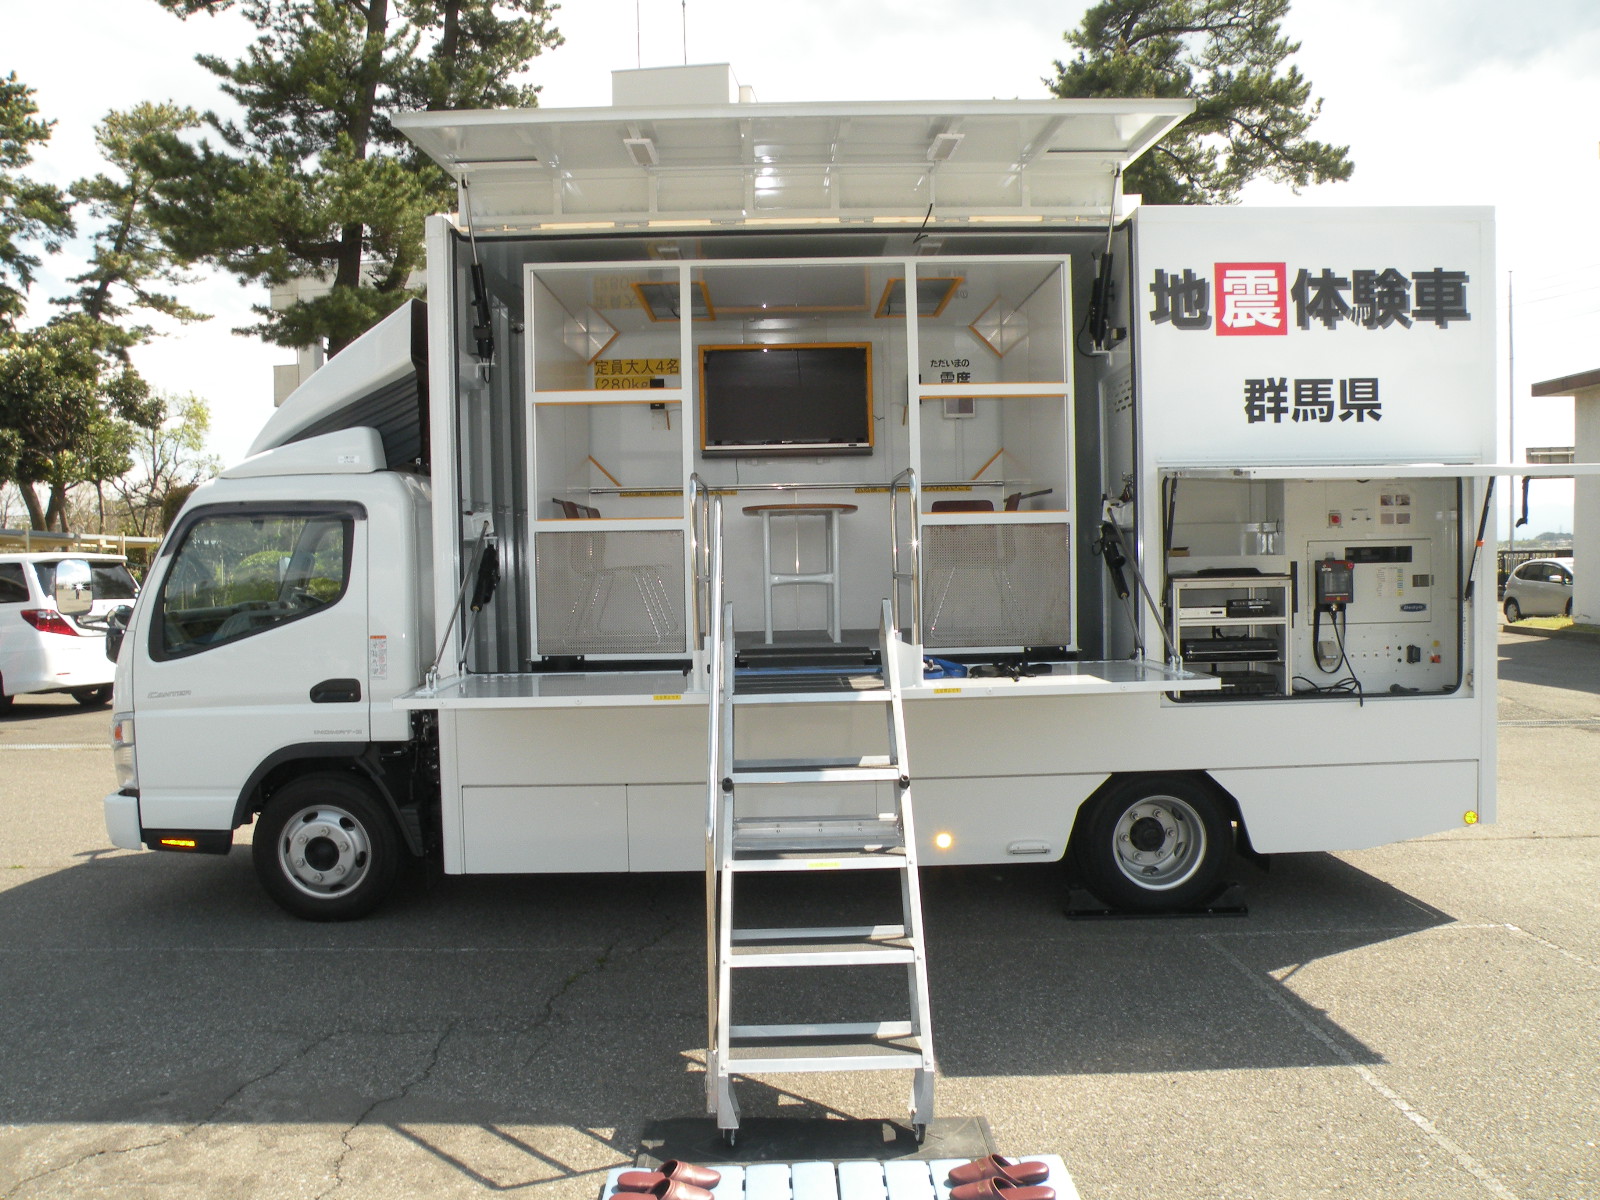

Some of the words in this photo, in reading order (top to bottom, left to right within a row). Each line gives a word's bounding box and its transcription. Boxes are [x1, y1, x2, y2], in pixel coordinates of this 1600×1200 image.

[1149, 265, 1471, 333] 地震体験車
[595, 358, 679, 376] 定員大人4名
[930, 359, 970, 368] ただいまの
[595, 377, 654, 389] (280kg
[1244, 377, 1382, 424] 群馬県
